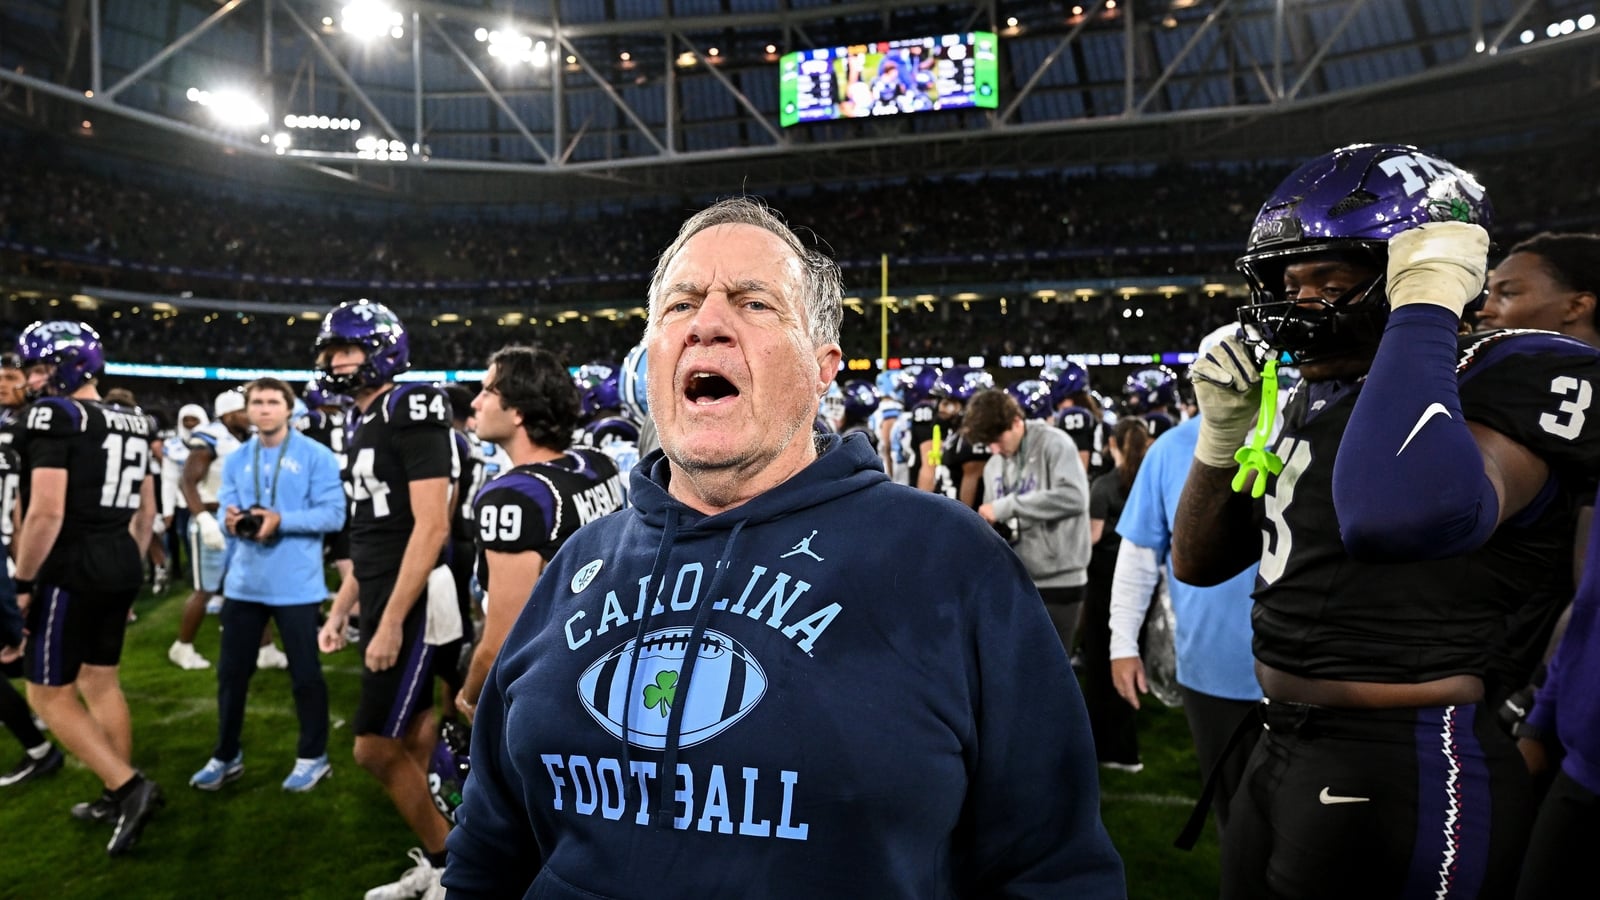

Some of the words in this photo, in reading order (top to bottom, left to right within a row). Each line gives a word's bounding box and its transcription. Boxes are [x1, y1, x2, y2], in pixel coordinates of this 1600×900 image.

[27, 407, 52, 430] 12
[409, 393, 445, 421] 54
[1538, 375, 1593, 441] 3
[101, 432, 150, 510] 12
[343, 447, 391, 518] 4
[480, 504, 523, 542] 99
[540, 753, 809, 841] FOOTBALL
